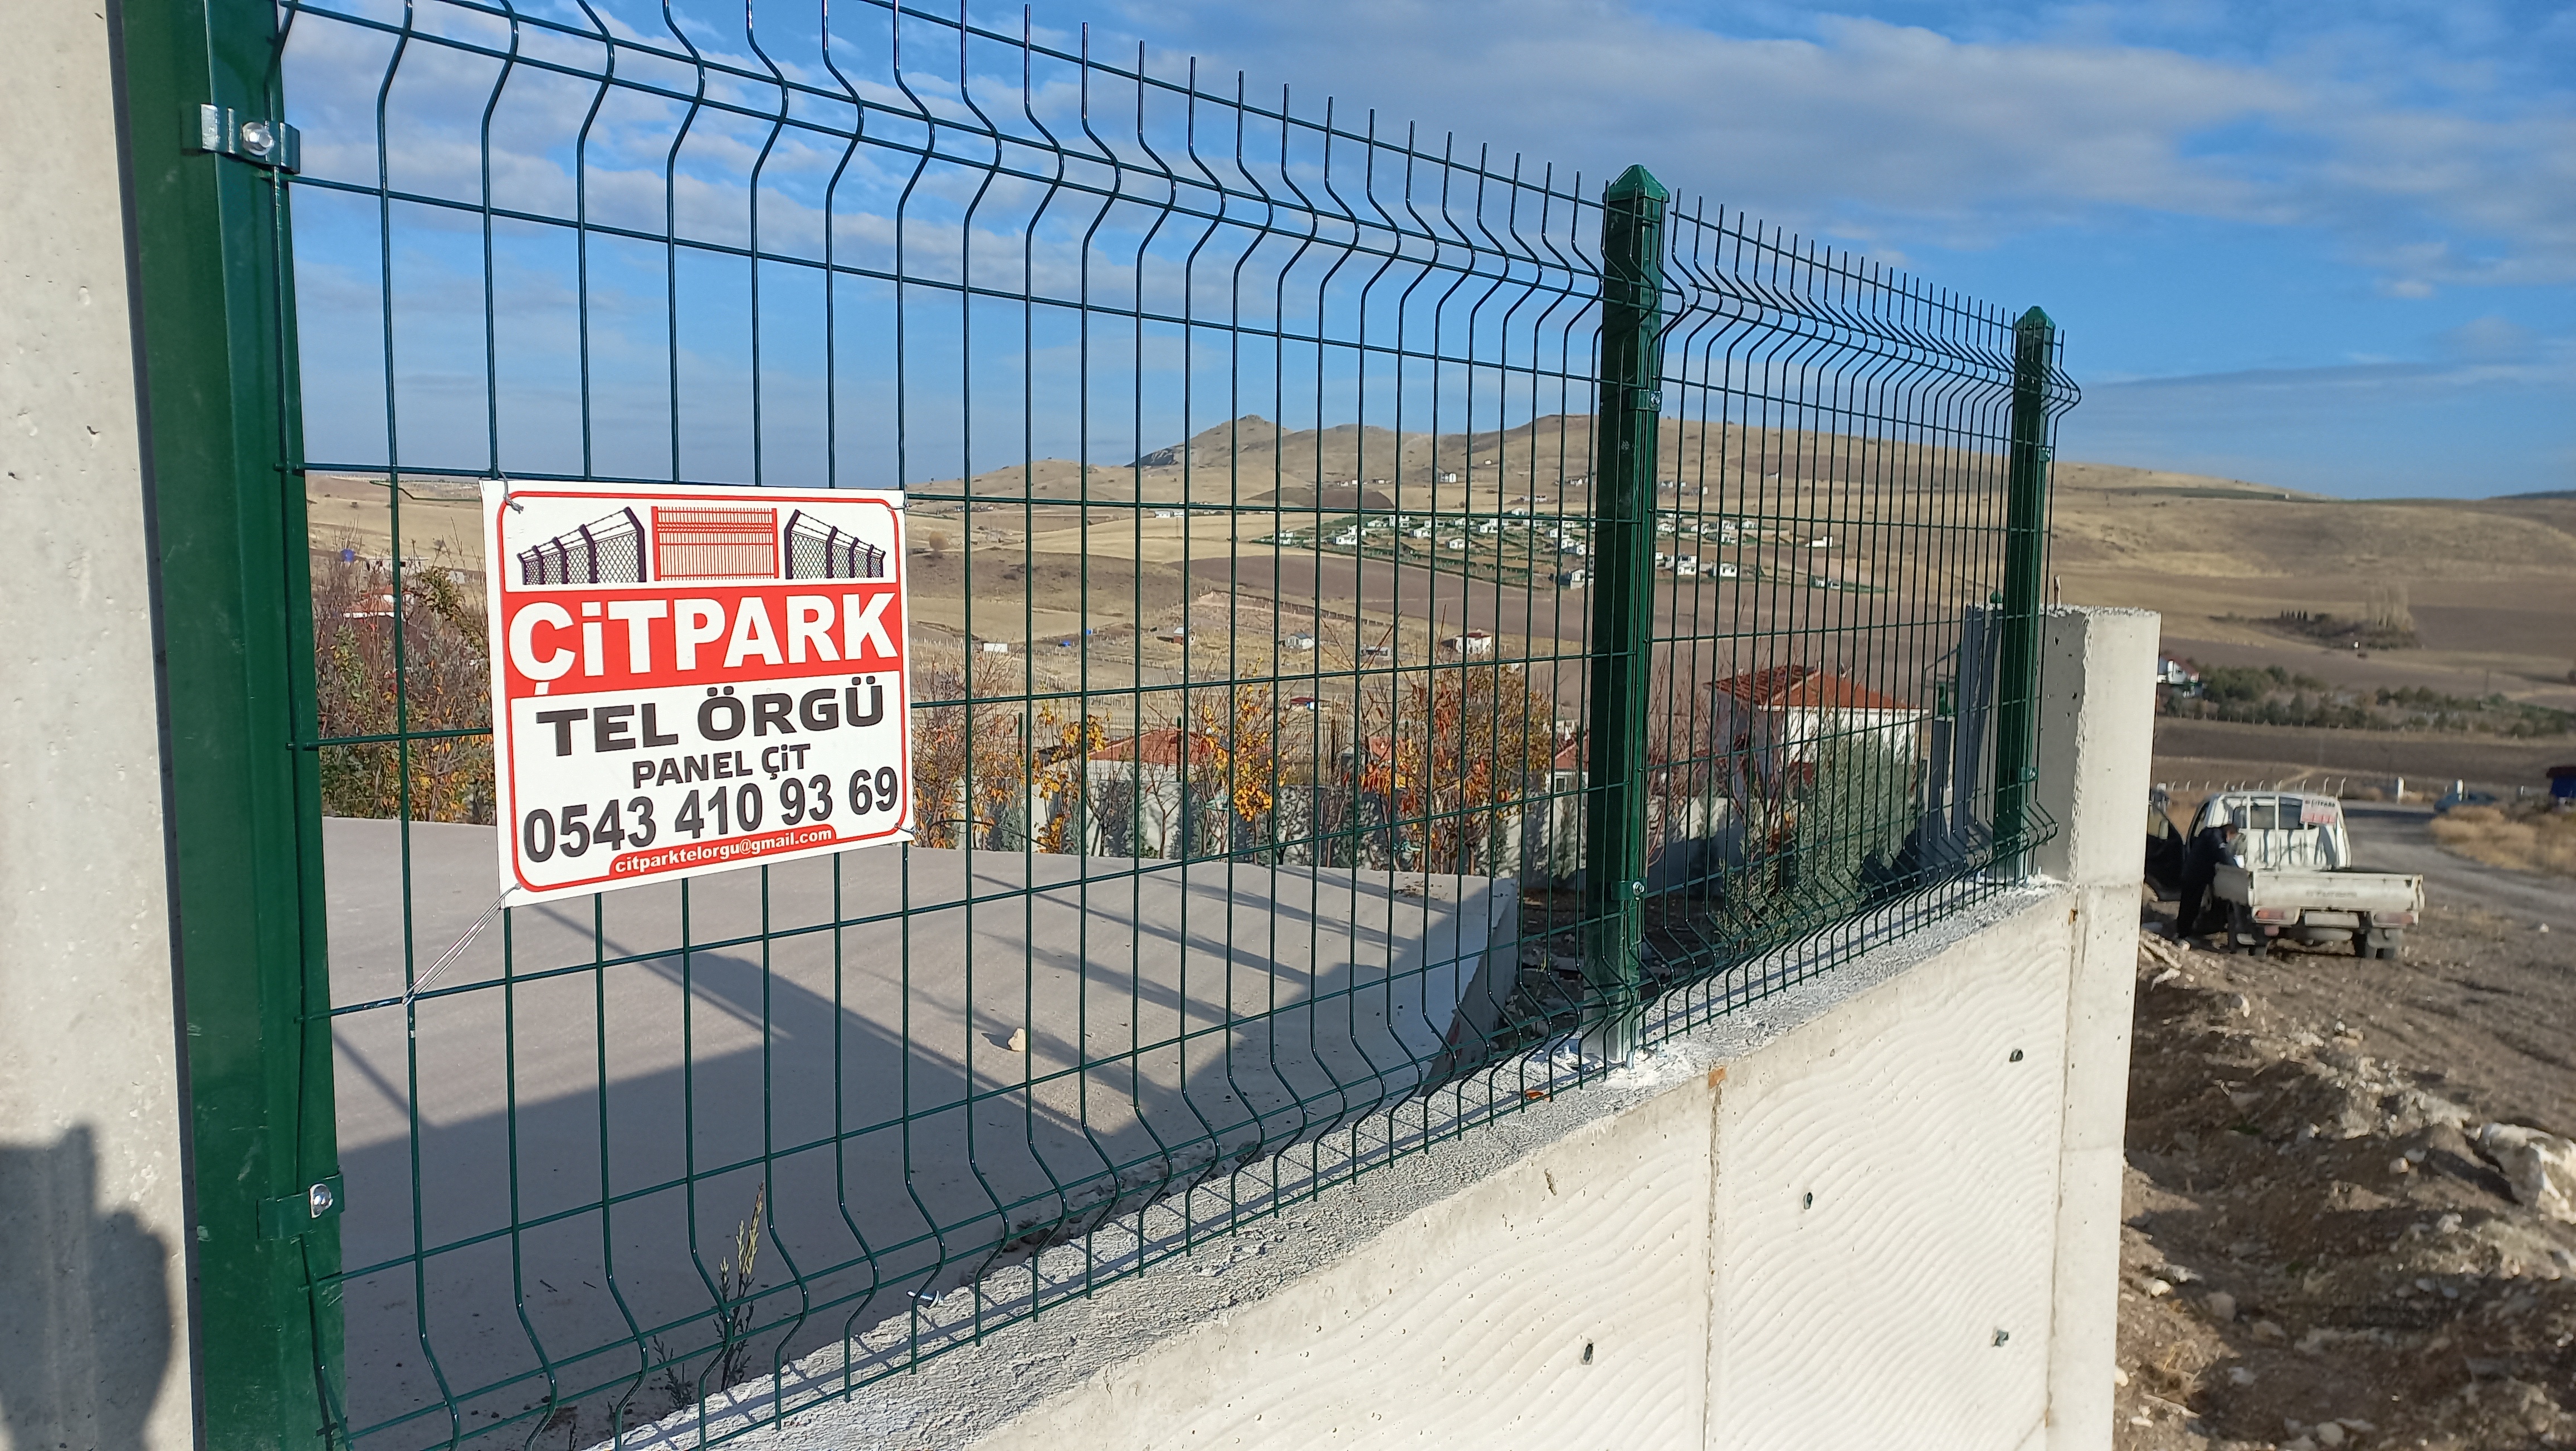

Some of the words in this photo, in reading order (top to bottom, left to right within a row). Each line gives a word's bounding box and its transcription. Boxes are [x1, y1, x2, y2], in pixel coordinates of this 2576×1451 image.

[535, 703, 679, 757] TEL
[697, 675, 884, 741] ÖRGÜ
[632, 750, 753, 789] PANEL
[524, 796, 656, 863] 0543
[675, 782, 763, 839] 410
[779, 774, 833, 826] 93
[848, 766, 898, 815] 69
[615, 827, 832, 873] citparktelorgu@gmail.com
